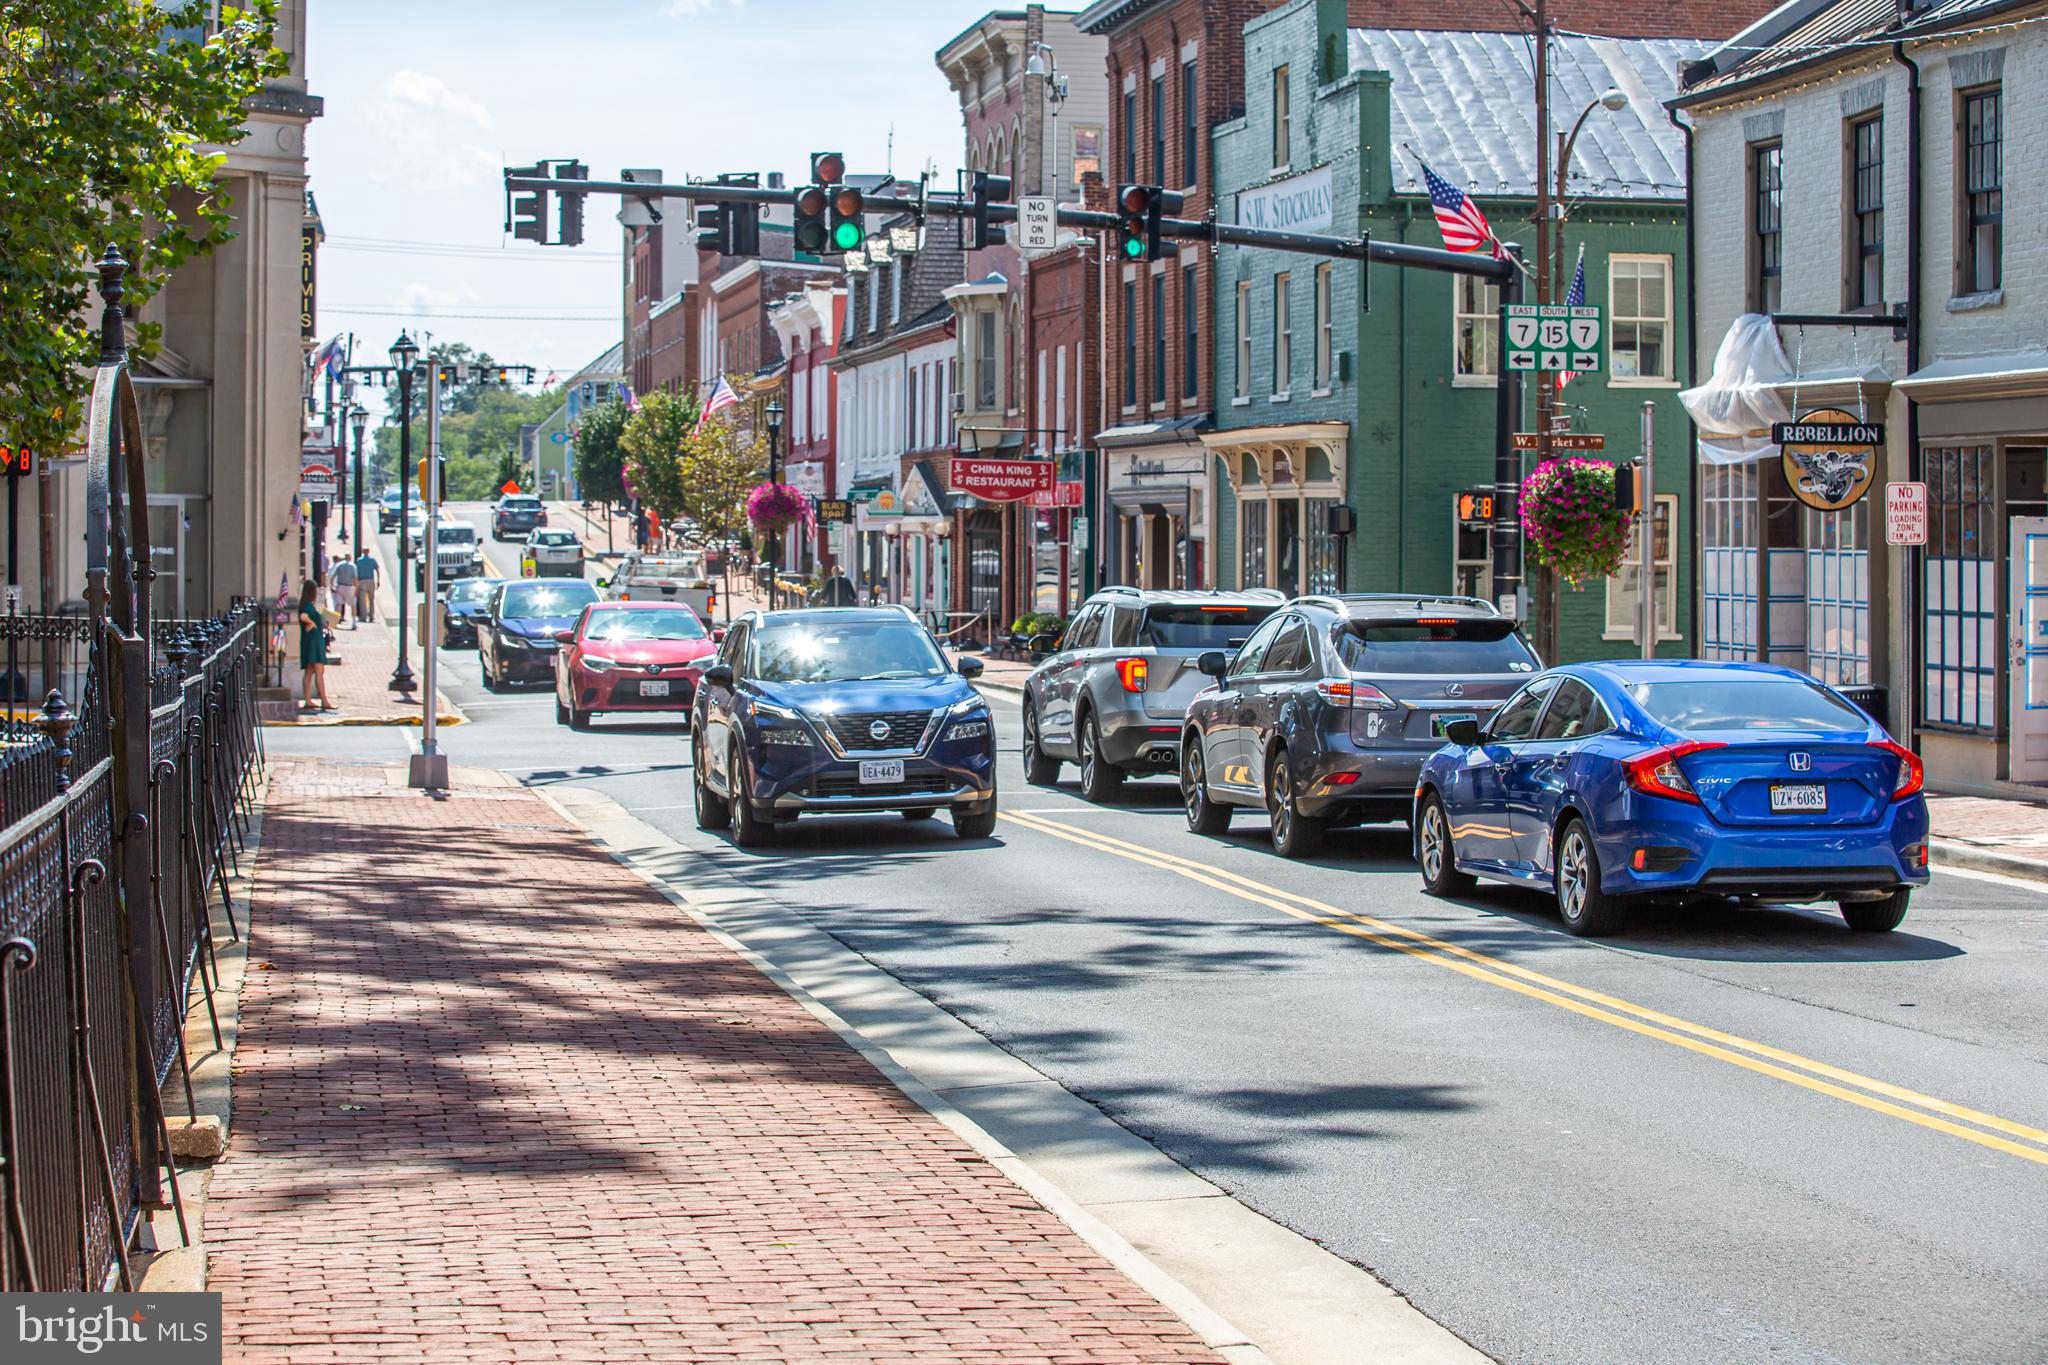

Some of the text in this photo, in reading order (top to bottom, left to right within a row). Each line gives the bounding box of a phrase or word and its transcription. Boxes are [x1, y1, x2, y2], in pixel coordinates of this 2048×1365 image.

[1028, 202, 1045, 211] NO
[1026, 214, 1048, 222] TURN
[1029, 236, 1045, 245] RED
[301, 236, 314, 328] PRIMIS
[1513, 305, 1533, 315] EAST
[1542, 307, 1566, 316] SOUTH
[1575, 308, 1595, 316] WEST
[1518, 324, 1529, 342] 7
[1546, 326, 1563, 344] 15
[1579, 326, 1590, 343] 7
[1782, 426, 1879, 443] REBELLION
[1516, 436, 1531, 447] W.
[1536, 436, 1573, 447] rket
[970, 464, 1004, 474] CHINA
[1006, 466, 1032, 475] KING
[965, 476, 1036, 488] RESTAURANT
[1898, 487, 1913, 498] NO
[1889, 501, 1922, 512] PARKING
[1890, 515, 1922, 523] LOADING
[1896, 523, 1916, 531] ZONE
[862, 767, 902, 778] UEA-4479
[1773, 791, 1824, 806] UZW-6085
